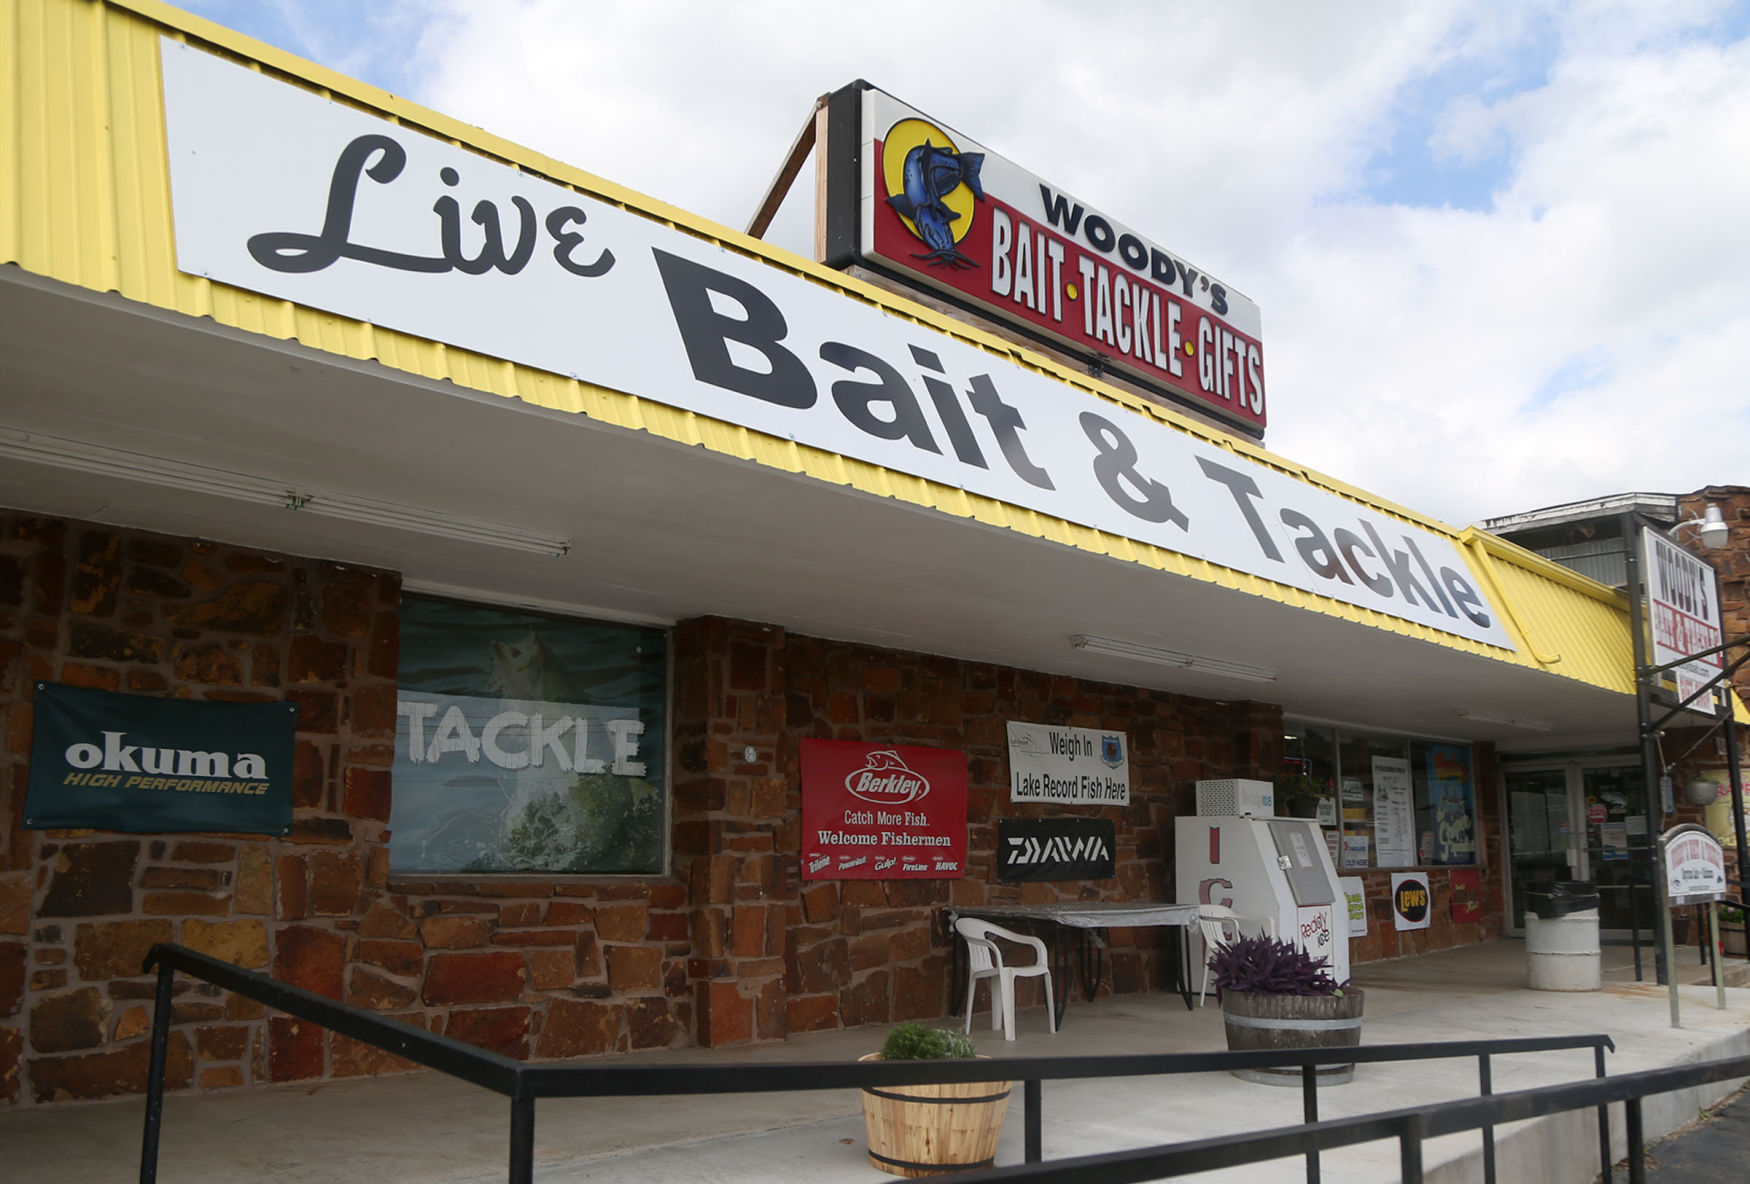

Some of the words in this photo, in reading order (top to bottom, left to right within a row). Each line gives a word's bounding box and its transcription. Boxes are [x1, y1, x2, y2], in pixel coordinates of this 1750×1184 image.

[1039, 183, 1229, 315] WOODY'S
[991, 205, 1065, 323] BAIT
[1078, 254, 1183, 378] TACKLE
[1198, 315, 1264, 416] GIFTS
[247, 134, 616, 277] Live
[651, 246, 1056, 491] Bait
[1078, 411, 1190, 533] &
[1193, 455, 1491, 629] Tackle
[397, 701, 647, 776] TACKLE
[1049, 731, 1081, 761] Weigh
[1083, 735, 1093, 756] In
[65, 731, 269, 779] okuma
[63, 772, 122, 787] HIGH
[125, 777, 270, 795] PERFORMANCE
[856, 772, 921, 801] Berkley
[1016, 772, 1041, 796] Lake
[1043, 774, 1078, 798] Record
[1081, 776, 1102, 799] Fish
[1104, 777, 1126, 800] Here
[844, 809, 873, 825] Catch
[877, 811, 902, 826] More
[818, 830, 878, 845] Welcome
[881, 832, 951, 847] Fishermen
[1007, 836, 1110, 865] DAIWA
